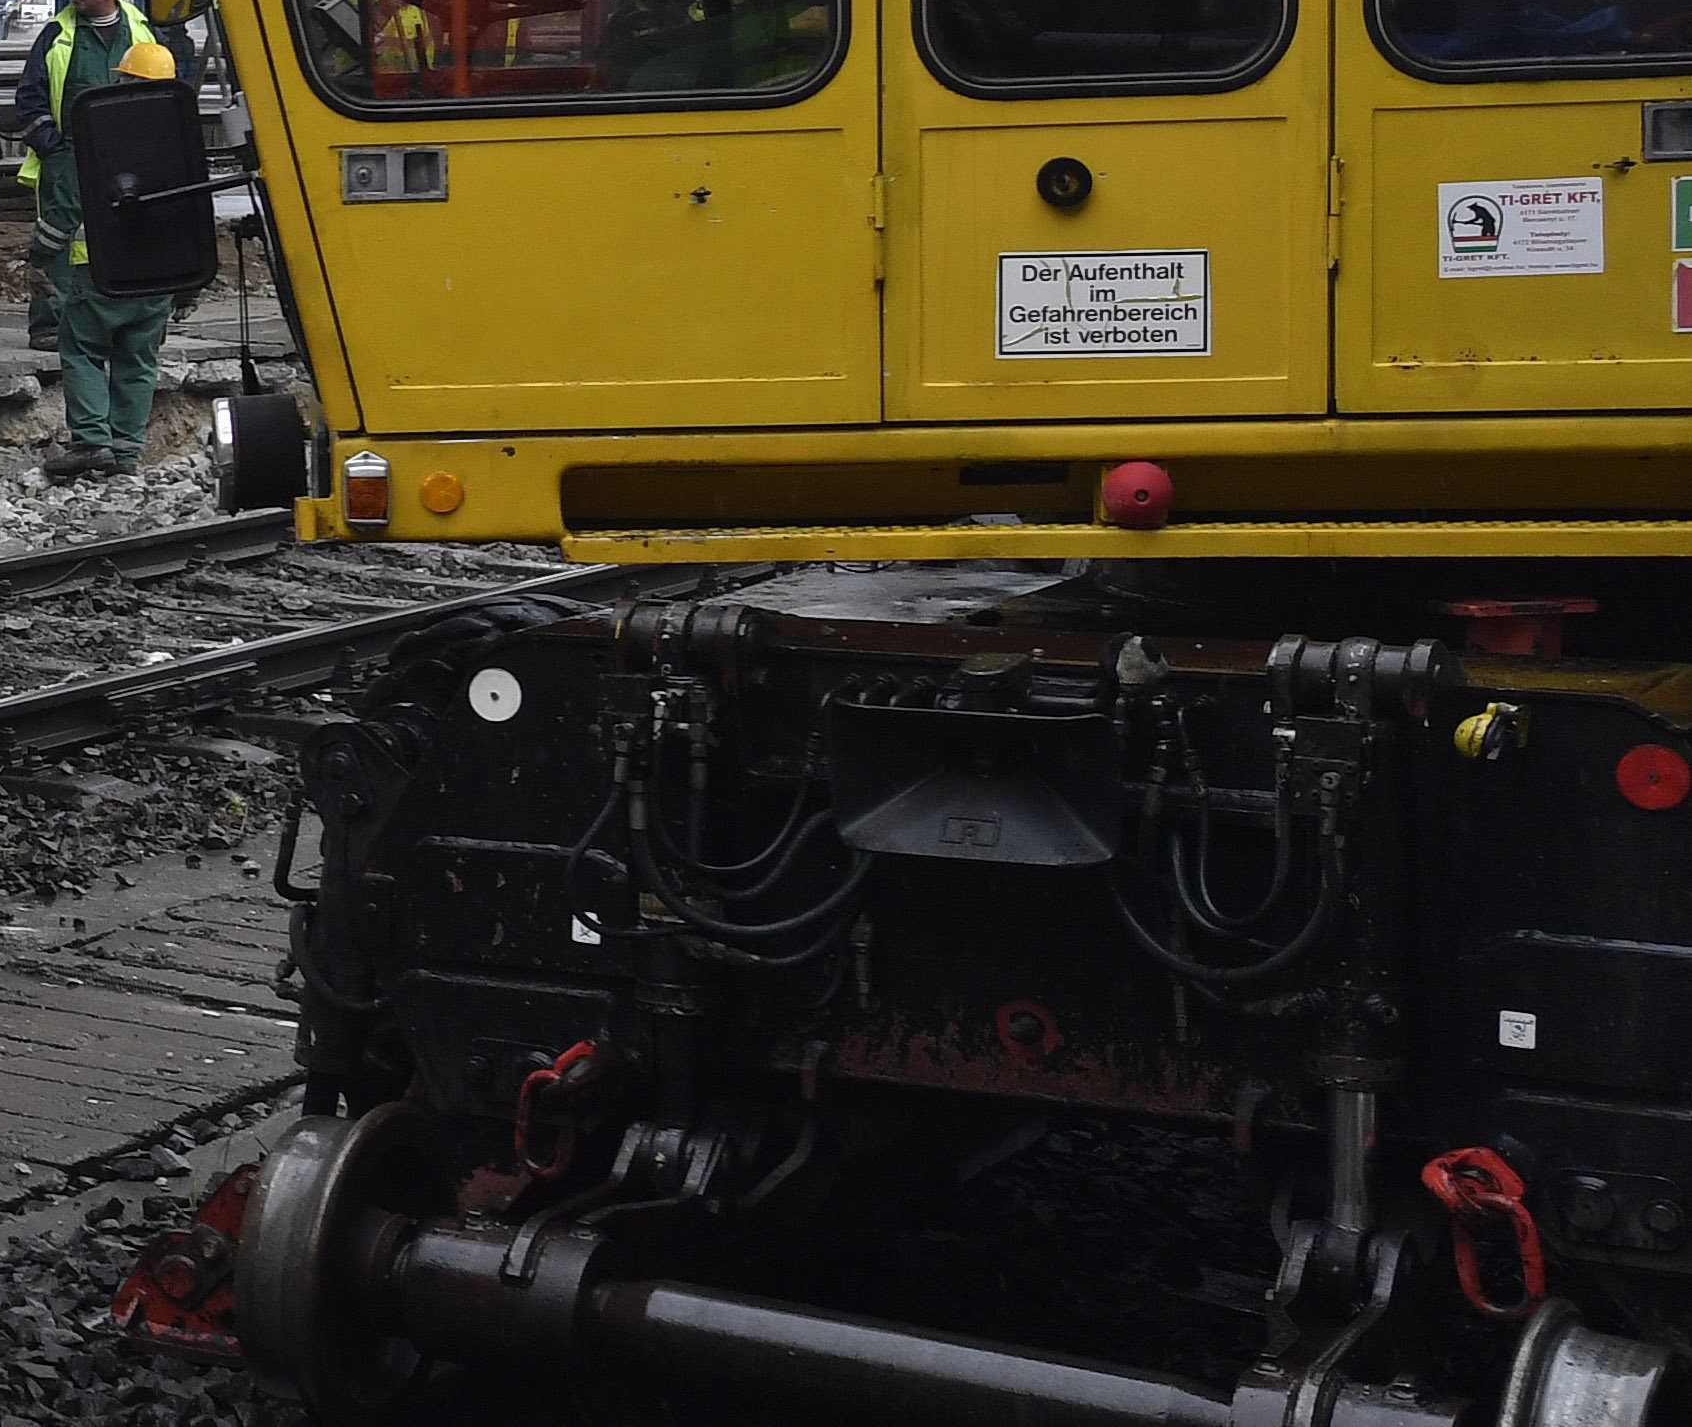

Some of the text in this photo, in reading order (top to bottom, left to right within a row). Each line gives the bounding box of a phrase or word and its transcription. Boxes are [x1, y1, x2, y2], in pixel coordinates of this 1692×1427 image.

[1498, 191, 1563, 206] TI-GRÉT
[1022, 262, 1185, 282] Der Aufenthalt
[1089, 285, 1116, 303] im
[1009, 304, 1198, 323] Gefahrenbereich
[1044, 326, 1178, 344] ist verboten
